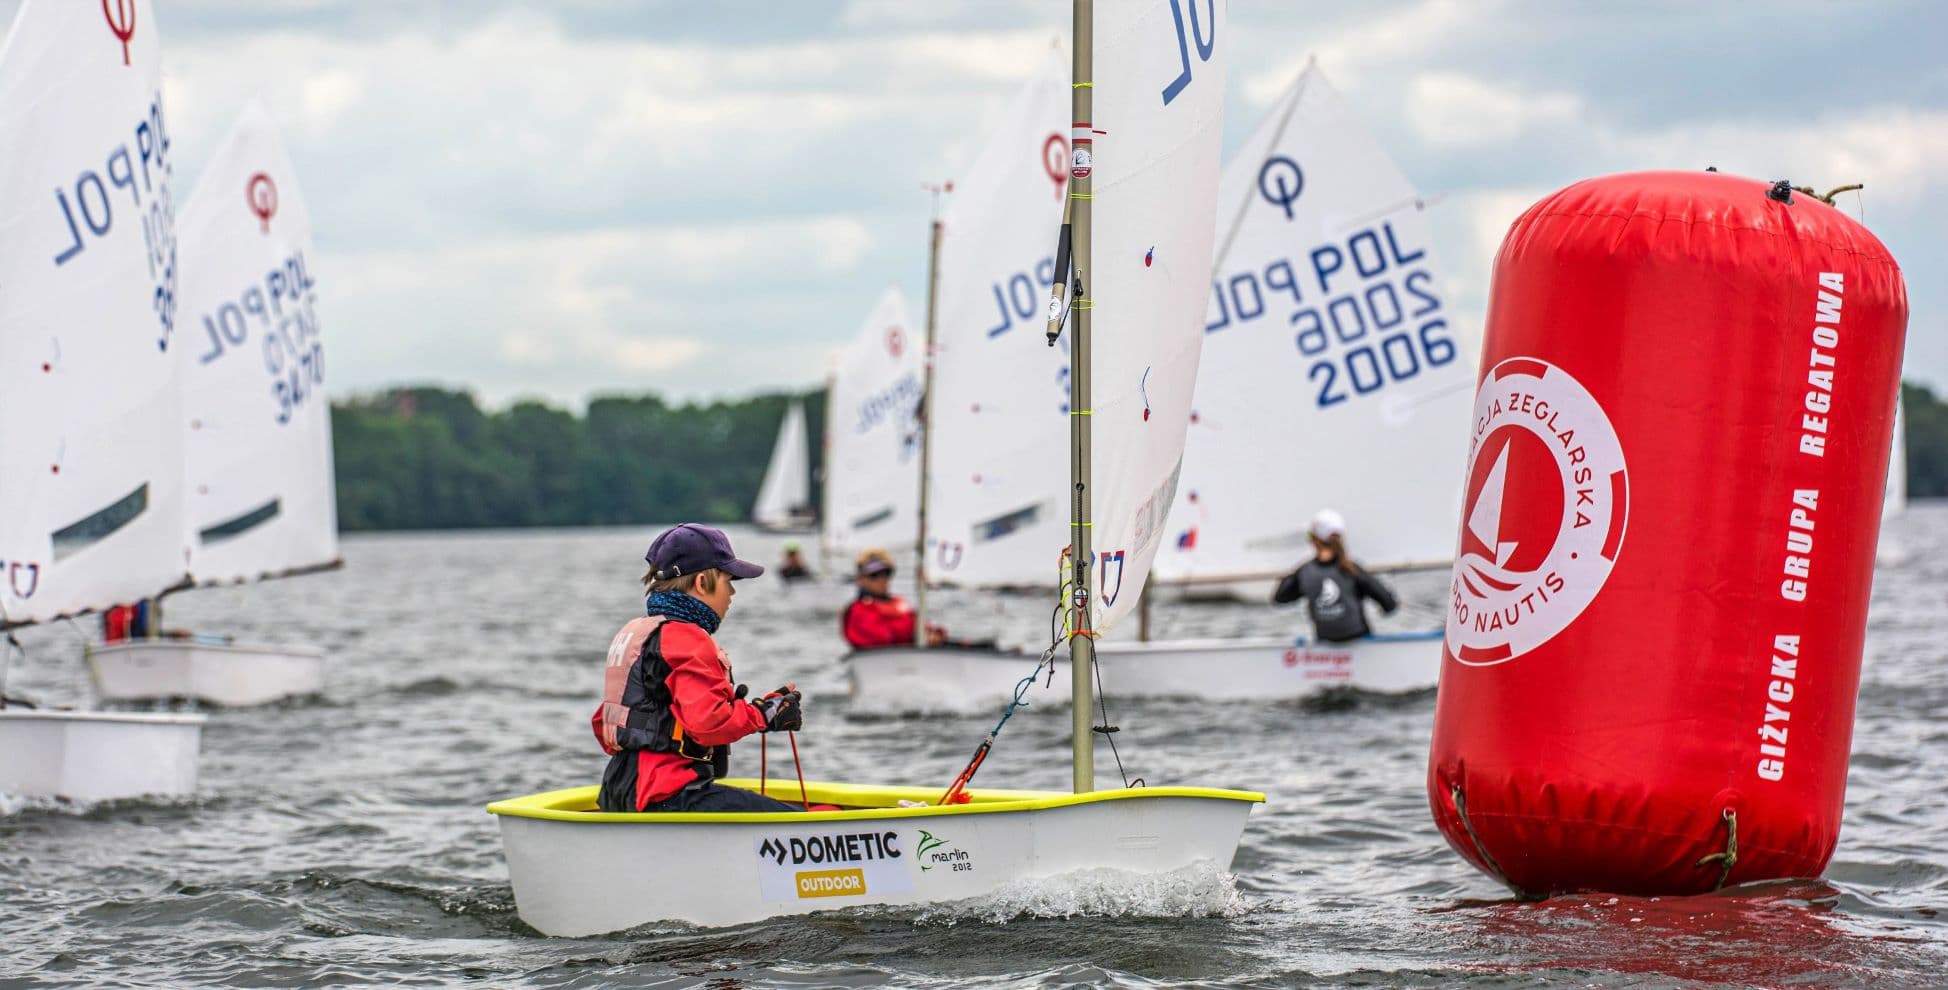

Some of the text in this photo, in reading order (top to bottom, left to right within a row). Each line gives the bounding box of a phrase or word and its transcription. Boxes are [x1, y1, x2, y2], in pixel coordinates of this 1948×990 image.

[1310, 221, 1425, 294] POL
[1308, 319, 1457, 409] 2006
[1757, 271, 1845, 781] GIŻYCKA GRUPA REGATOWA
[1452, 571, 1564, 633] PRO NAUTIS
[790, 831, 902, 865] DOMETIC
[931, 847, 970, 863] marlin
[953, 862, 973, 872] 2012
[800, 876, 861, 892] OUTDOOR
